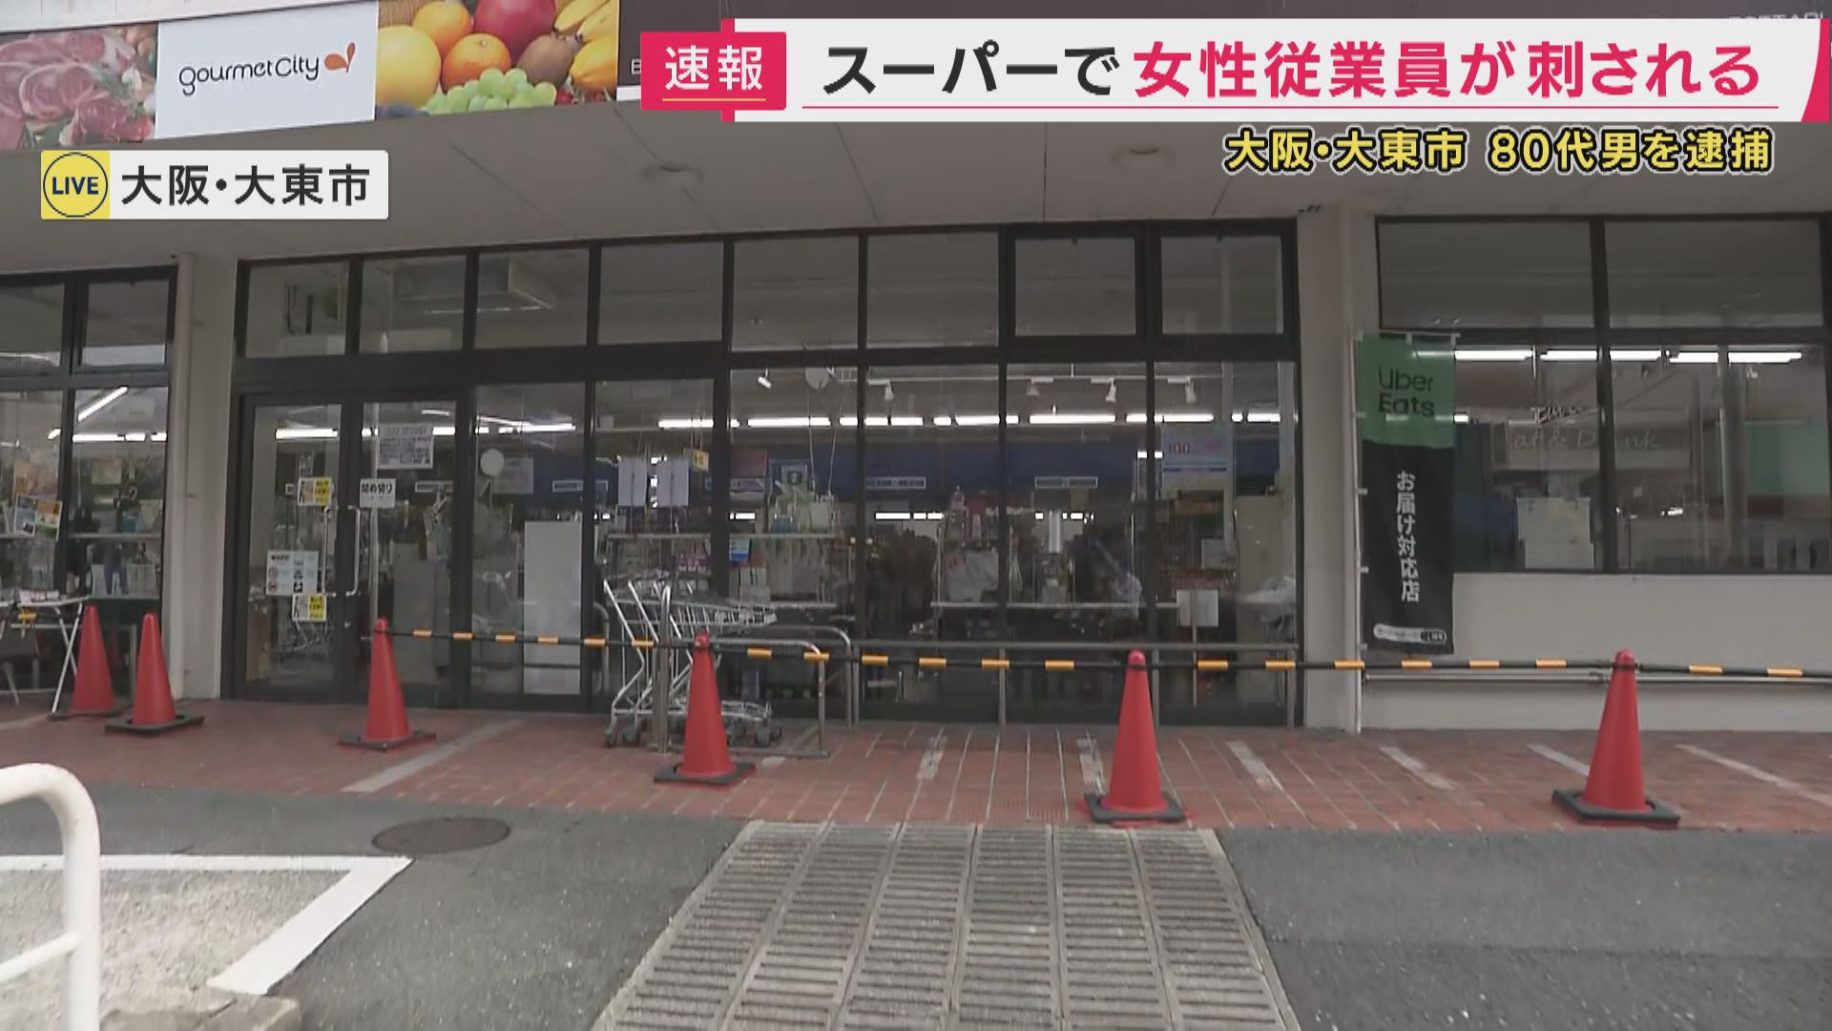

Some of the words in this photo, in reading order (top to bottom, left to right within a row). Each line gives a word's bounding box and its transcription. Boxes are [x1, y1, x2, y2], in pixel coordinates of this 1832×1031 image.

[1378, 366, 1434, 392] Uber
[1378, 392, 1435, 417] Eats
[1396, 470, 1420, 602] お届け対応店
